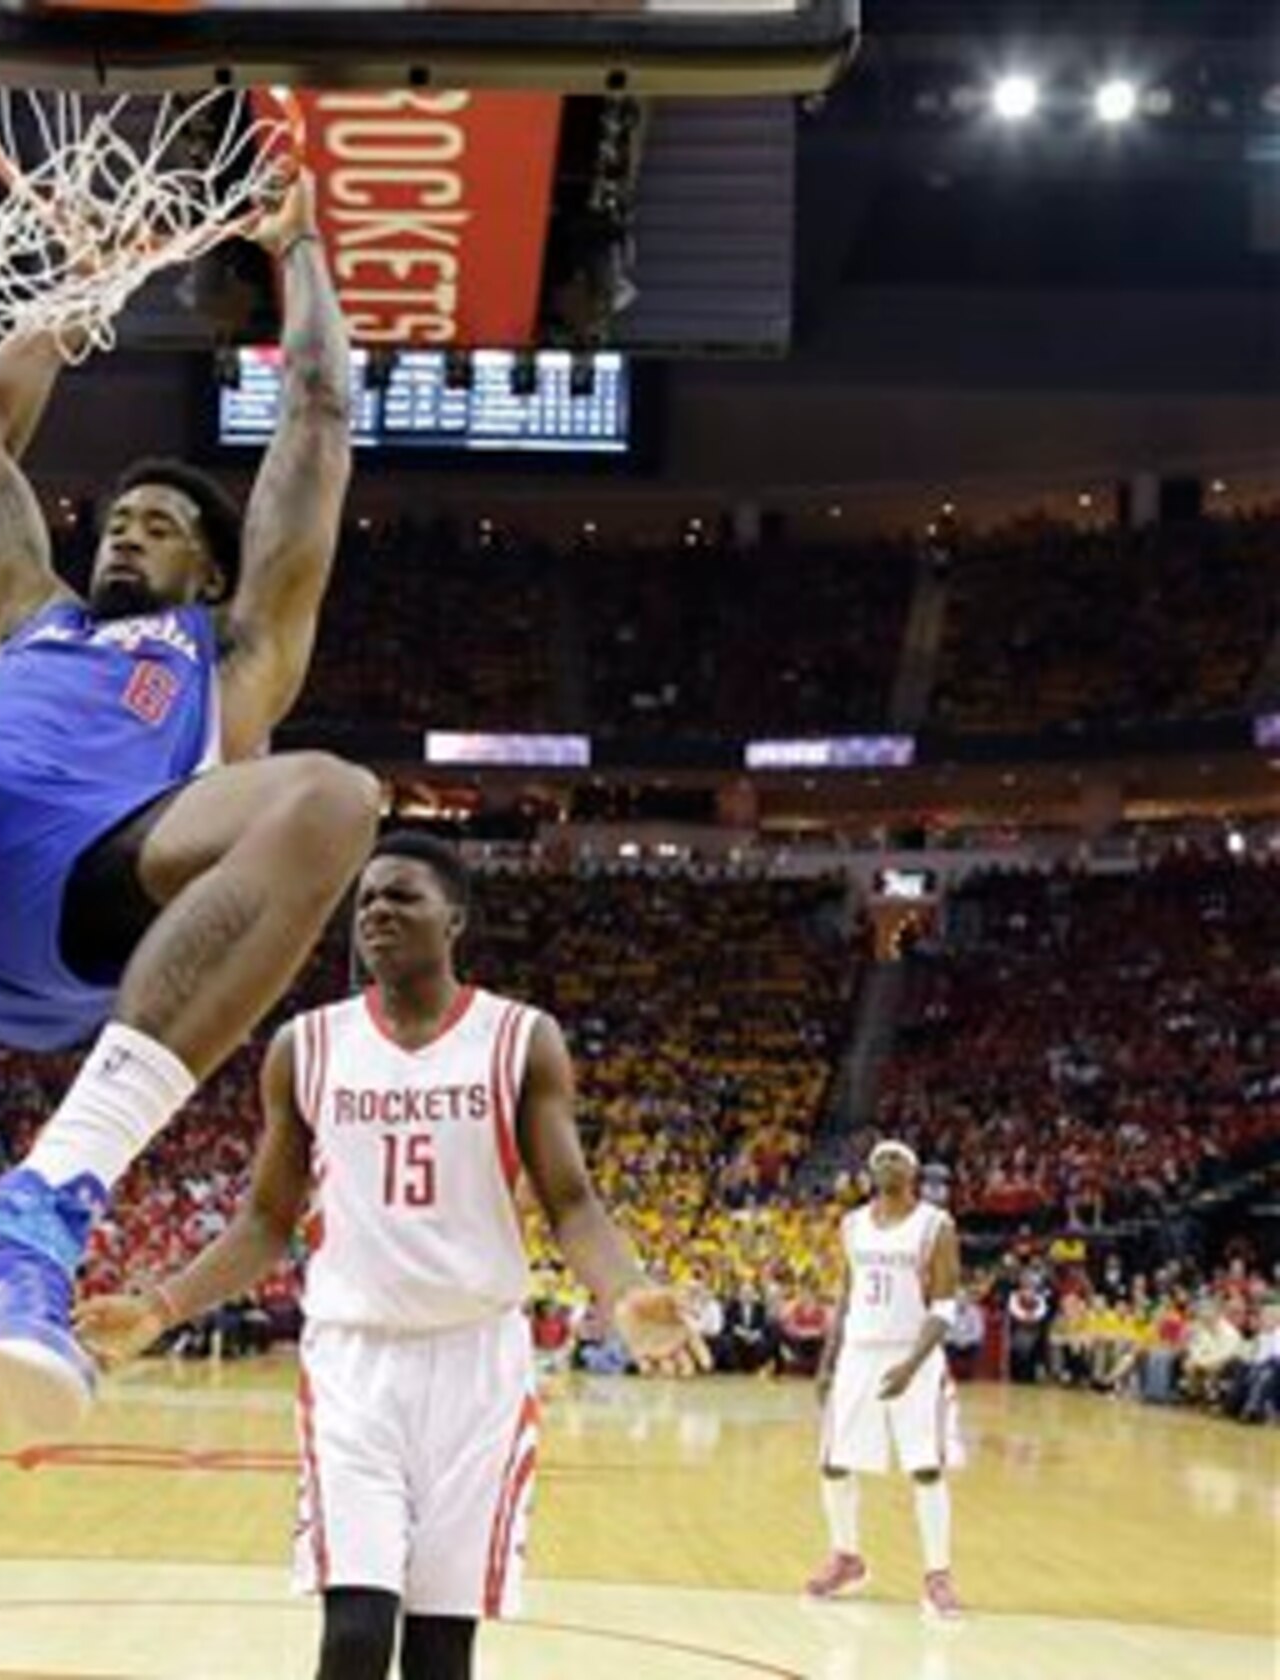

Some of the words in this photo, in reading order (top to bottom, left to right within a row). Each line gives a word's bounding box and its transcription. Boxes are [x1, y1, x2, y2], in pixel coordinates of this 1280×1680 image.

[334, 1083, 488, 1125] ROCKETS
[382, 1133, 436, 1206] 15
[865, 1268, 893, 1310] 31
